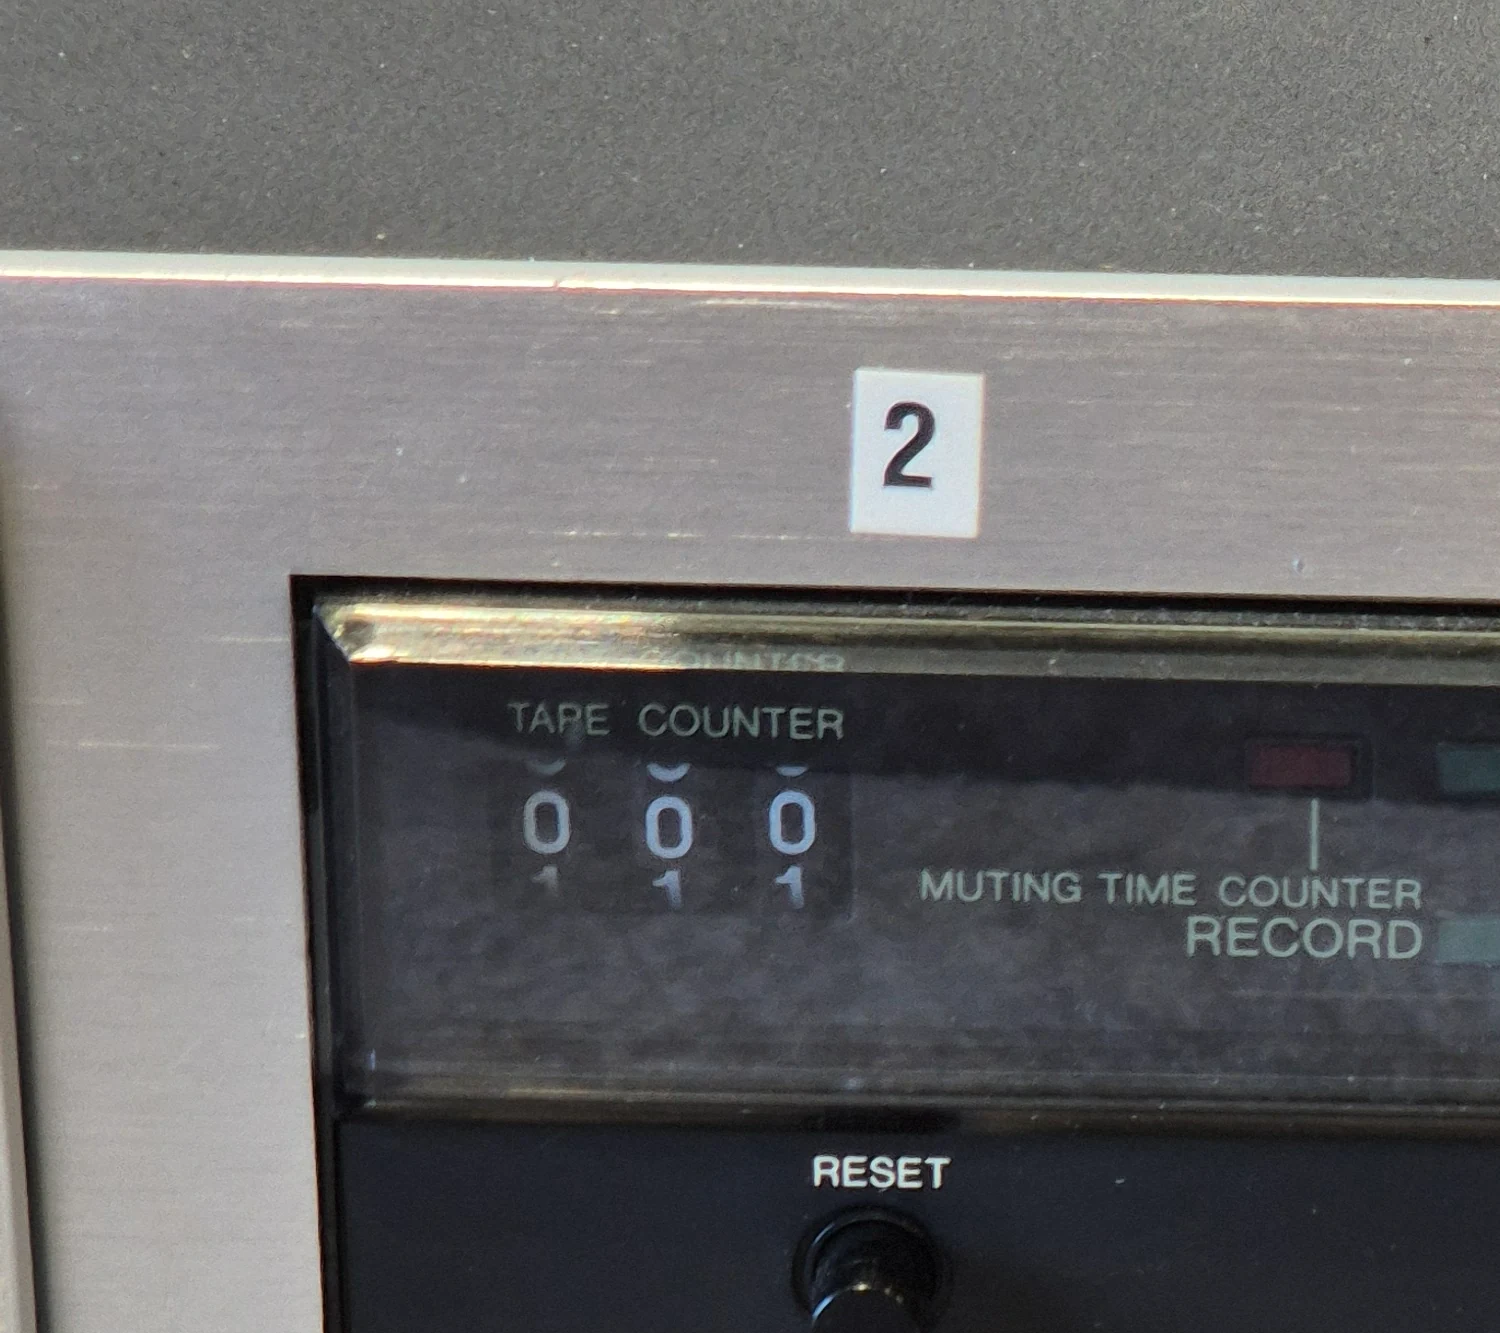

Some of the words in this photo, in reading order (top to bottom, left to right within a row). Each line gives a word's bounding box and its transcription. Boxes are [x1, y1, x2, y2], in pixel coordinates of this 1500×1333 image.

[882, 401, 937, 489] 2
[509, 702, 611, 736] TAPE
[638, 702, 845, 740] COUNTER
[920, 868, 1082, 904] MUTING
[1099, 872, 1197, 907] TIME
[1218, 875, 1423, 910] COUNTER
[1184, 914, 1423, 960] RECORD
[811, 1153, 953, 1190] RESET
